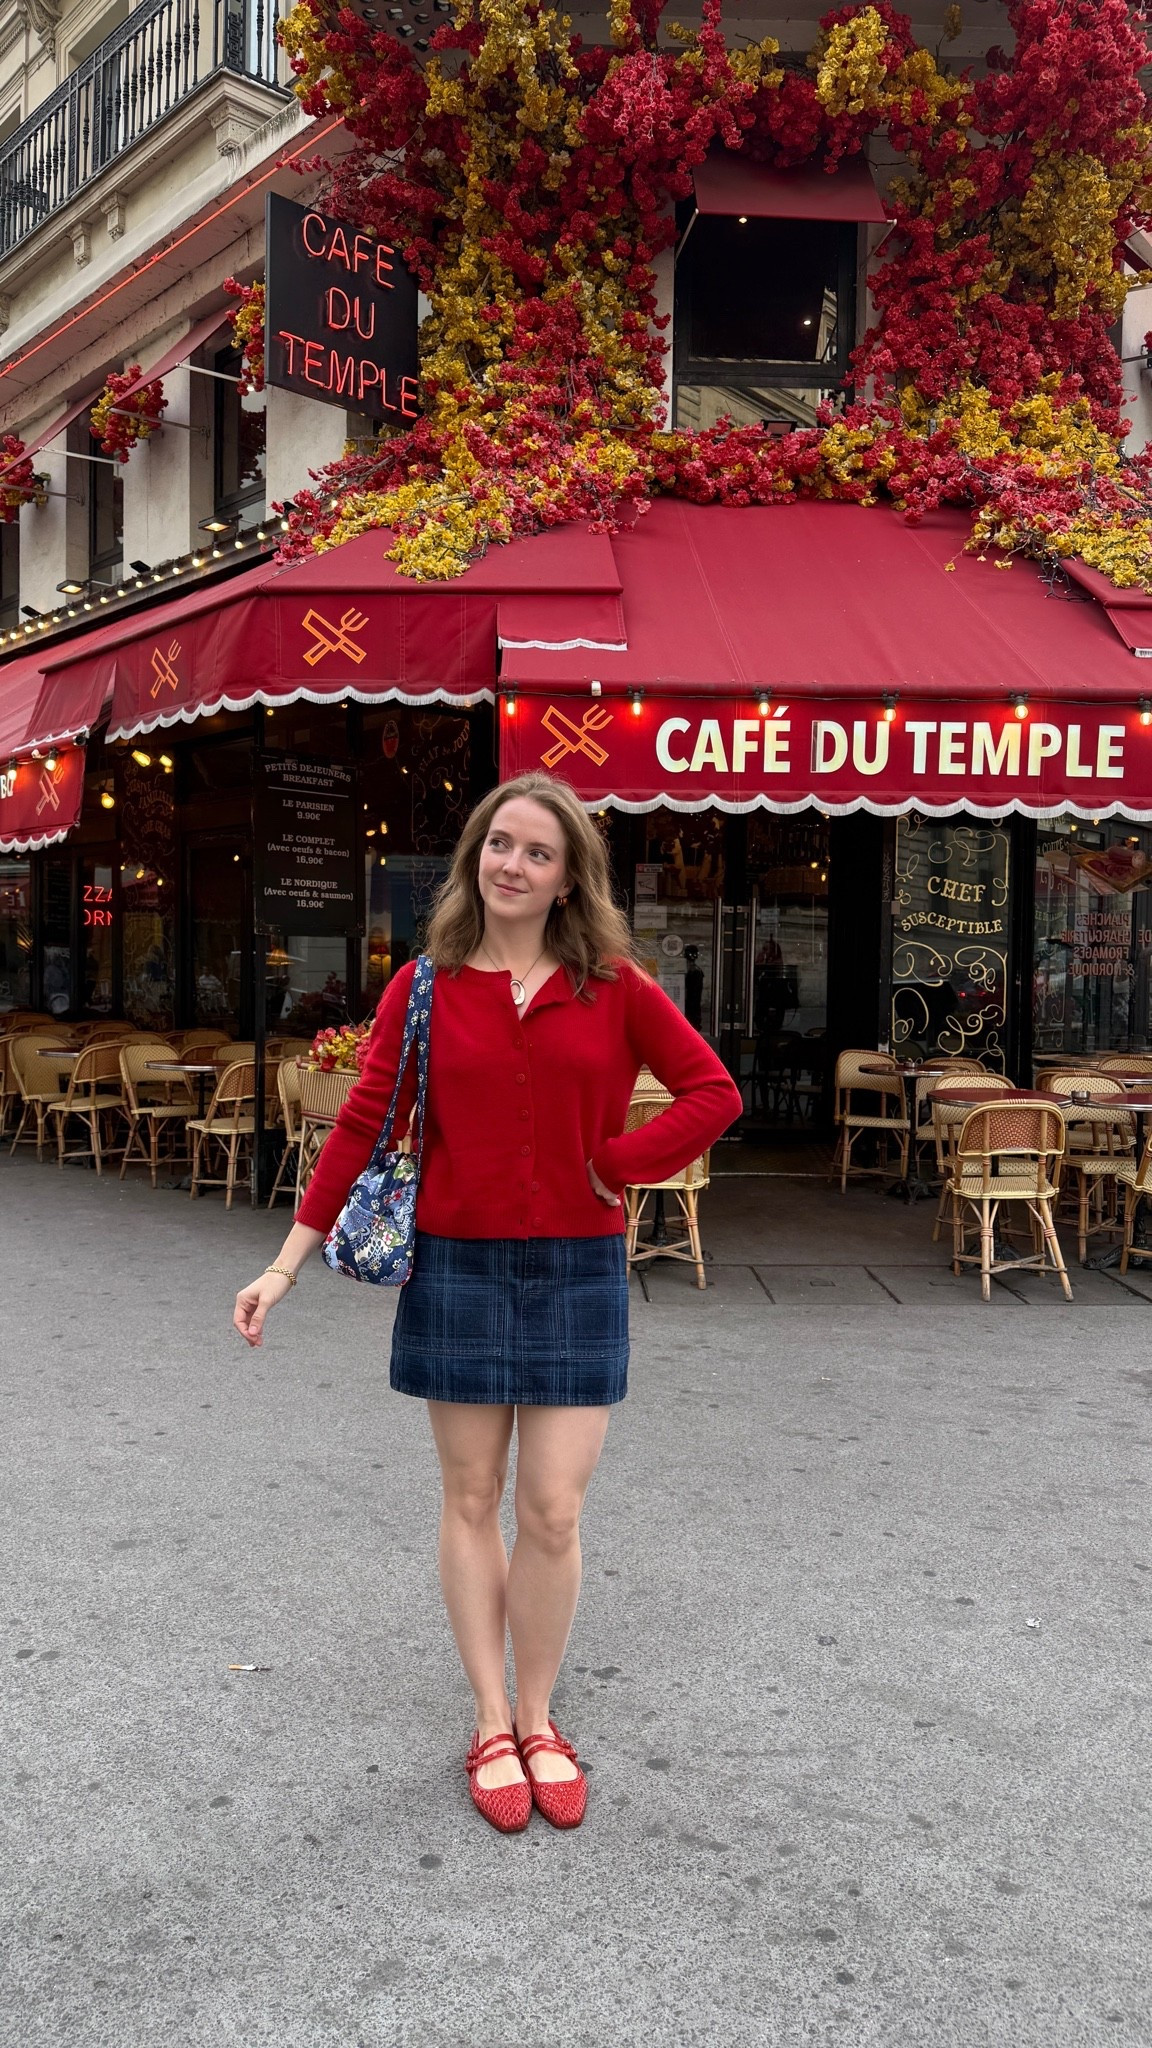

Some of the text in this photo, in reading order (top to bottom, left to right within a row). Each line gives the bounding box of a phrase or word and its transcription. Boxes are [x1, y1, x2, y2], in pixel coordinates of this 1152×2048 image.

[303, 213, 395, 289] CAFE
[328, 286, 375, 340] DU
[279, 330, 419, 418] TEMPLE
[655, 705, 1126, 779] CAFÉ DU TEMPLE
[264, 763, 352, 782] PETITS DEJEUNERS
[282, 773, 334, 787] BREAKFAST
[282, 799, 335, 812] LE PARISIEN
[282, 833, 335, 846] LE COMPLET
[267, 842, 350, 858] (Avec oeufs & bacon)
[264, 886, 354, 901] (Avec oeufs & saumon)
[280, 878, 338, 890] LE NORDIQUE
[927, 875, 987, 903] CHEF
[901, 911, 1003, 934] SUSCEPTIBLE
